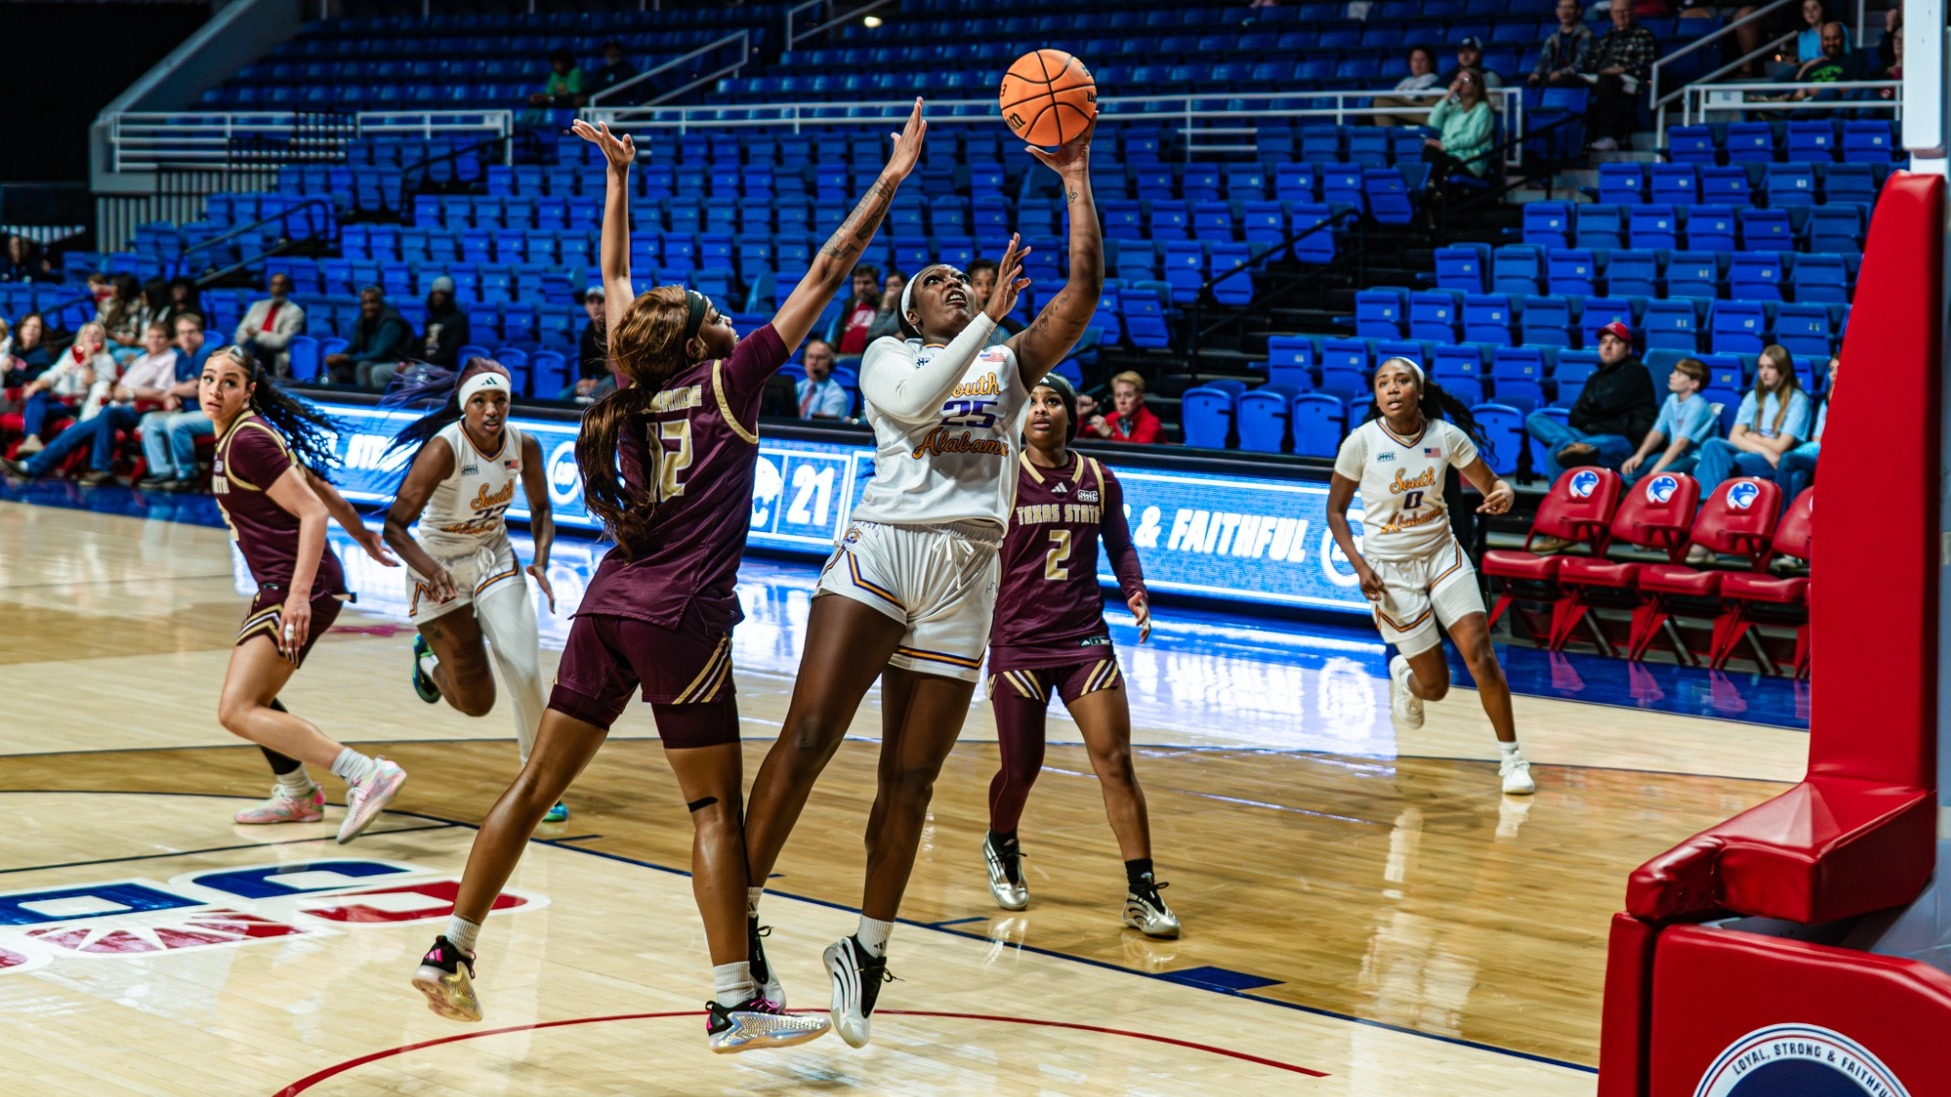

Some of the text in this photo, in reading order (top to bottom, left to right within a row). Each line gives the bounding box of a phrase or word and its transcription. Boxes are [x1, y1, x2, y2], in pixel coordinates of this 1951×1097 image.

[952, 371, 1001, 398] outh
[940, 400, 999, 429] 25
[646, 418, 694, 503] 12
[1390, 466, 1436, 494] South
[786, 464, 835, 526] 21
[1016, 504, 1060, 526] TEXAS
[1403, 491, 1424, 510] 0
[1134, 506, 1162, 549] &
[1167, 508, 1309, 563] FAITHFUL
[1045, 529, 1073, 581] 2
[1732, 1042, 1892, 1097] LOYAL, STRONG & FAITHFU
